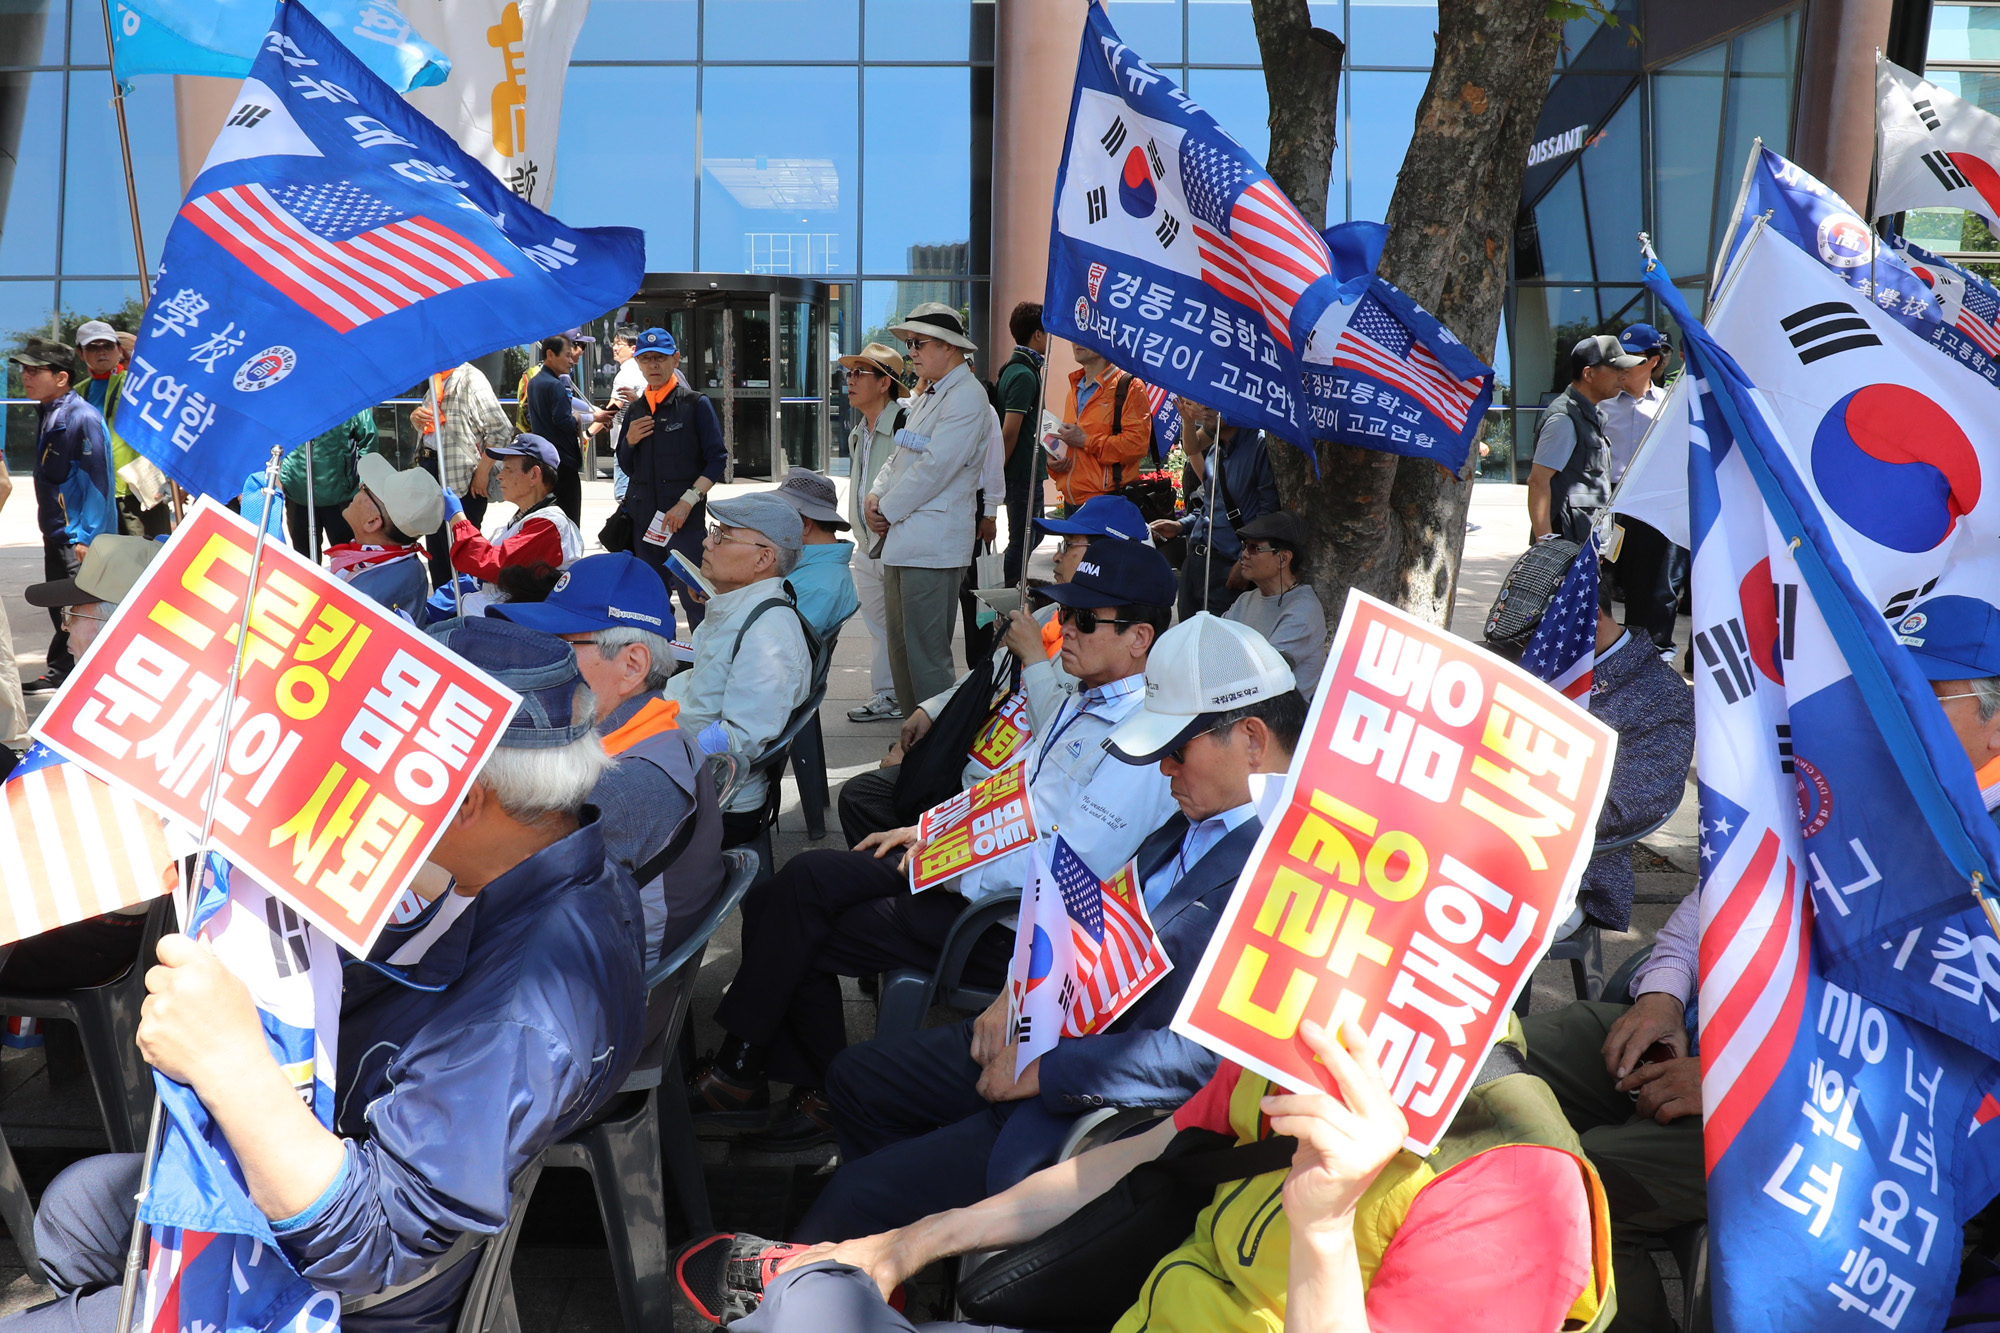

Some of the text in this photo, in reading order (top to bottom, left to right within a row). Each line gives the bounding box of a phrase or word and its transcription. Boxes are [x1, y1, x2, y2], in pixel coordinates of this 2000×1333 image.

[1527, 123, 1589, 167] OISSANT
[150, 262, 247, 374] 學校
[1090, 308, 1204, 382] 나라지킴이
[1108, 271, 1283, 373] 경동고등학교
[120, 355, 217, 453] 교연합
[1312, 373, 1423, 425] 경남고등학교
[1346, 412, 1438, 450] 고교연합
[148, 532, 492, 807] 드루킹 몸통
[72, 633, 425, 925] 문재인 사퇴
[1090, 800, 1109, 815] weather
[919, 825, 973, 881] 사퇴
[972, 798, 1030, 856] 몸통
[1217, 620, 1484, 1064] 드루킹 몸통
[1365, 681, 1596, 1118] 문재인 사퇴
